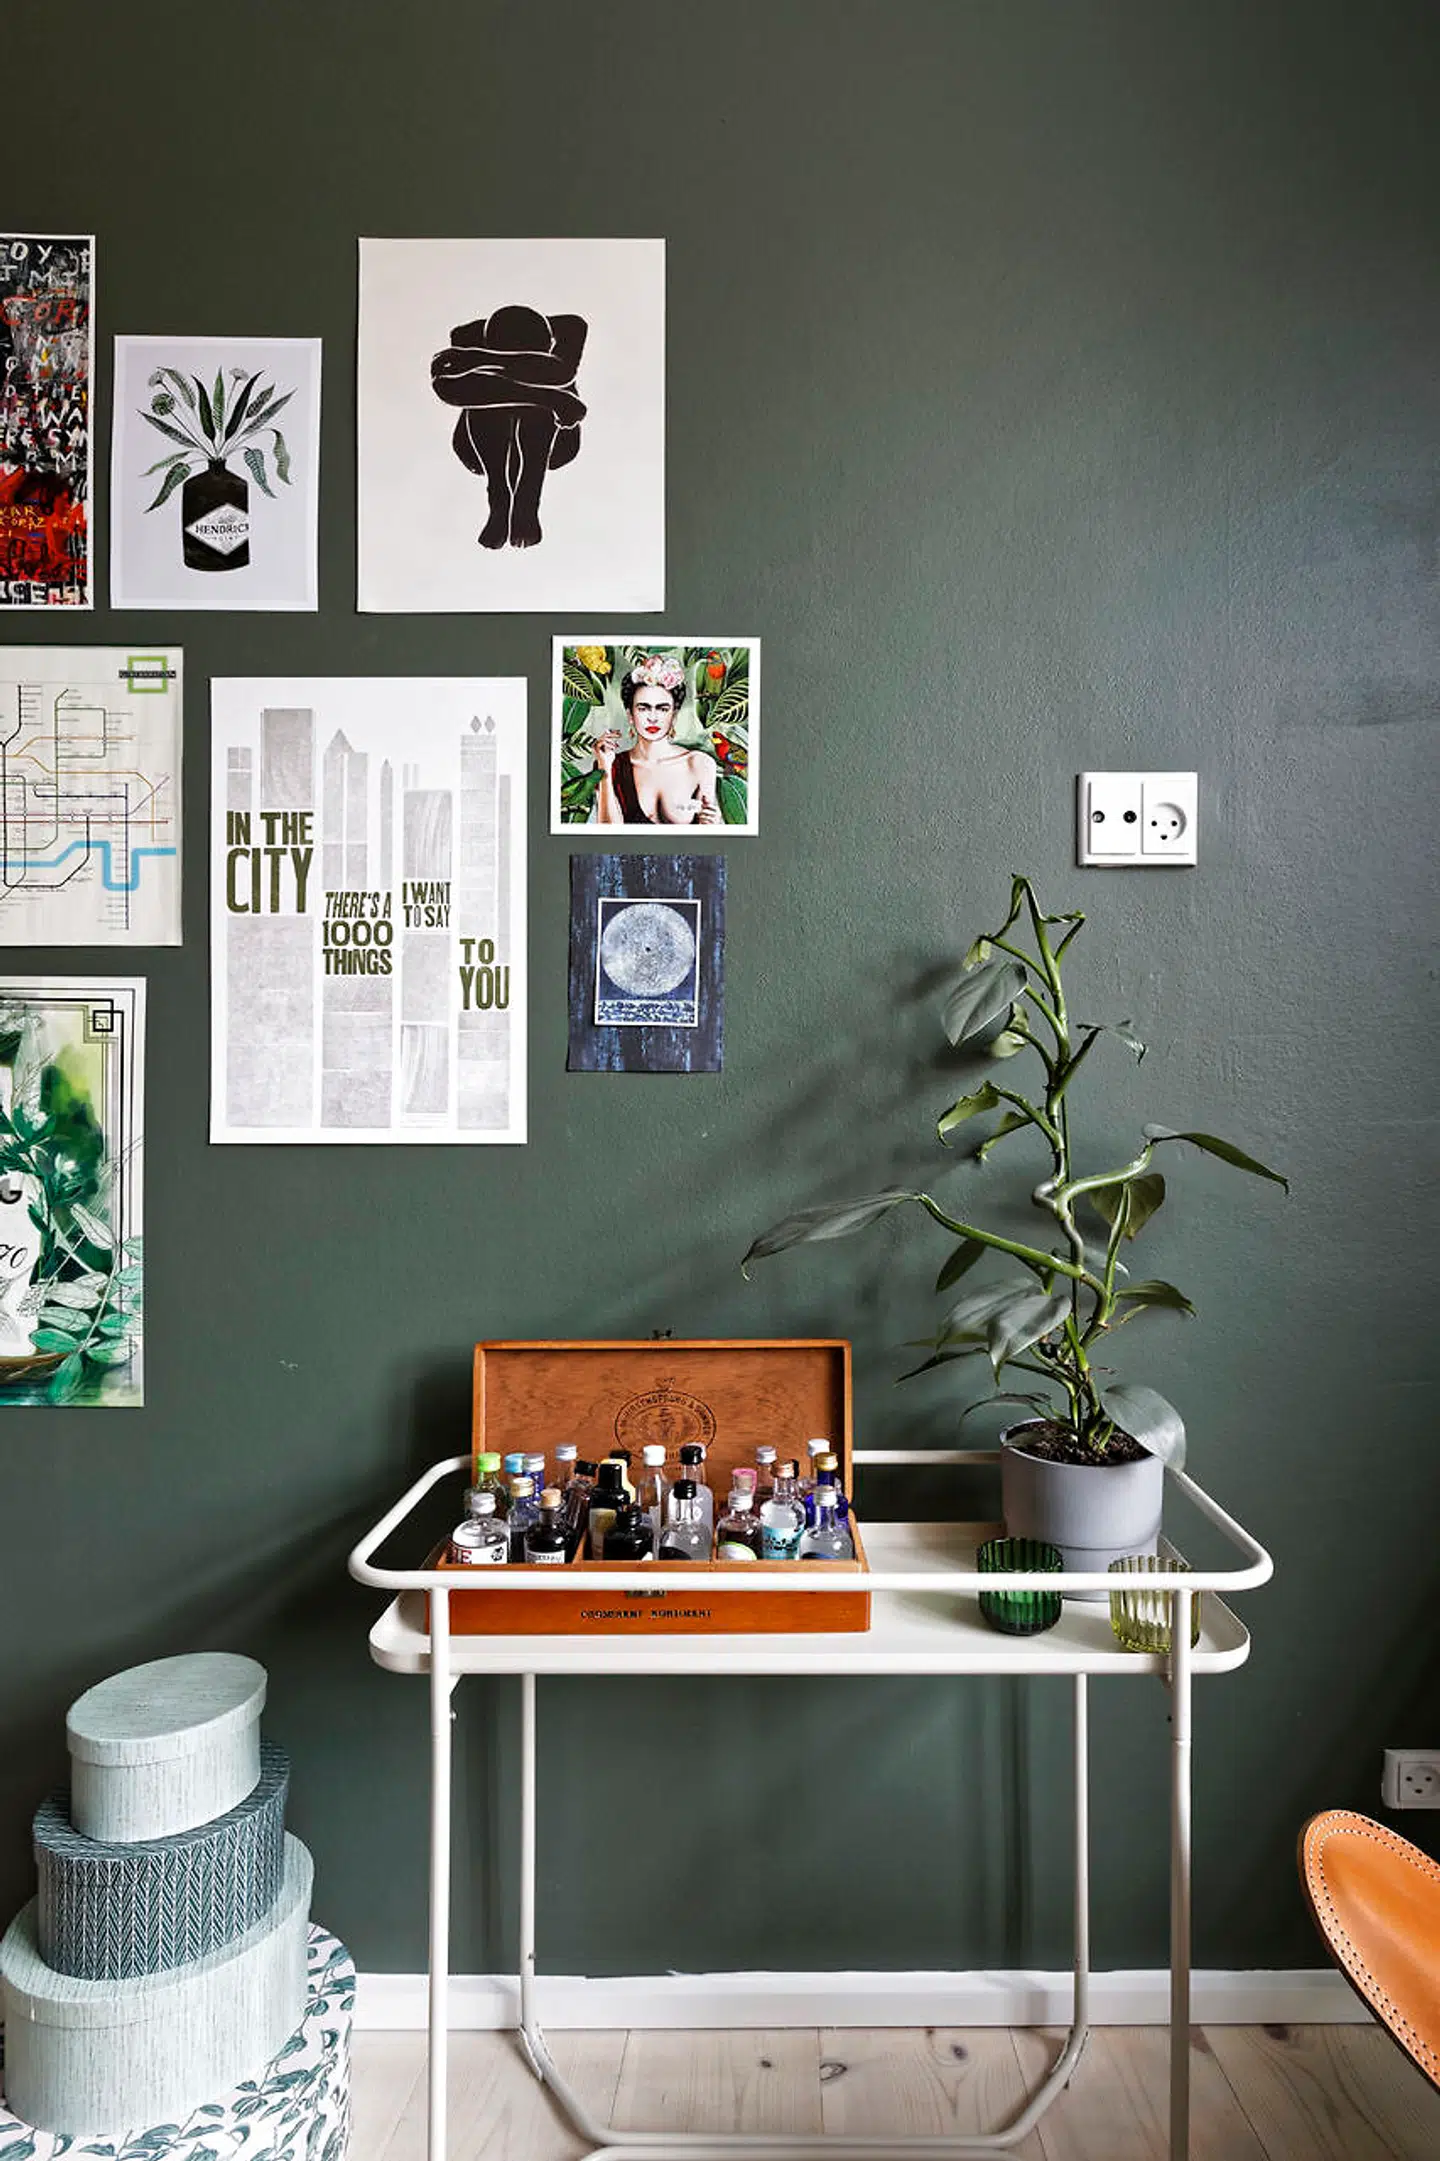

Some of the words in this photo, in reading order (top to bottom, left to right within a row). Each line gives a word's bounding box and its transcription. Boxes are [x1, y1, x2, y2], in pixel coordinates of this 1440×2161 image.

[226, 811, 250, 845] IN
[260, 812, 314, 845] THE
[226, 848, 313, 914] CITY
[402, 882, 409, 904] I
[411, 881, 452, 904] WANT
[325, 891, 380, 918] THERE'S
[382, 891, 392, 918] A
[403, 905, 421, 928] TO
[425, 906, 451, 928] SAY
[322, 920, 393, 946] 1000
[322, 949, 393, 976] THINGS
[460, 938, 495, 965] TO
[459, 966, 510, 1010] YOU
